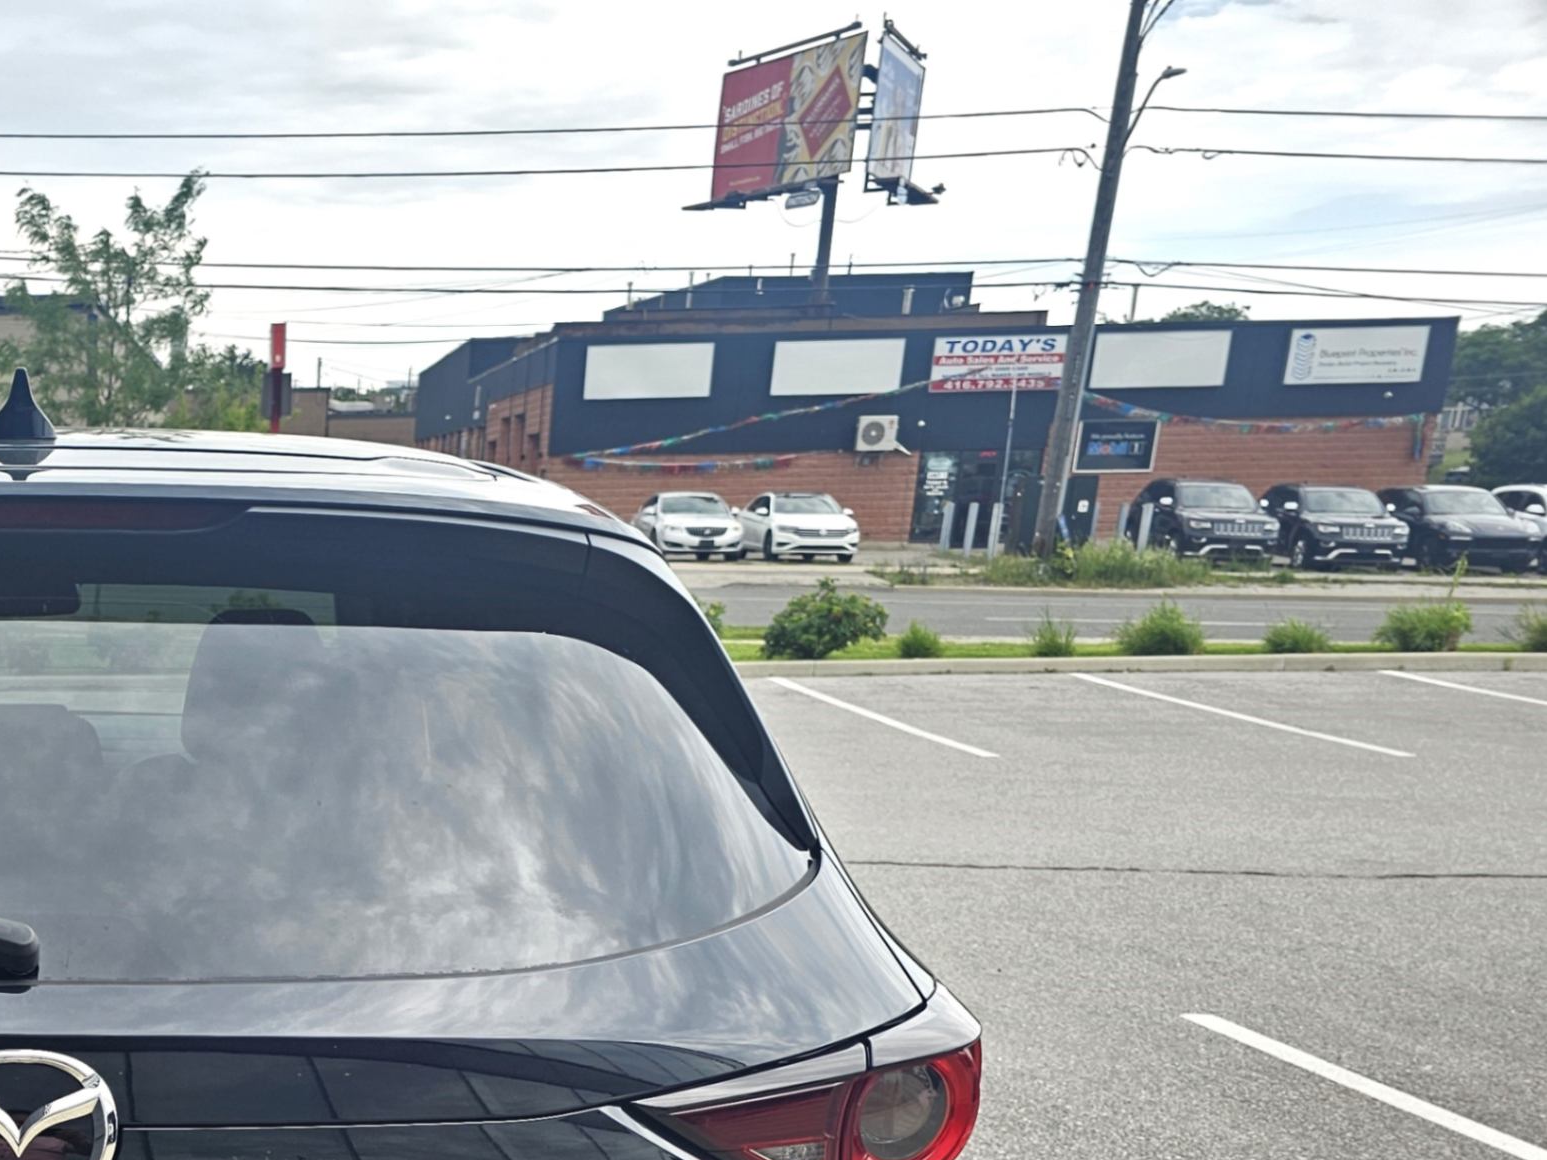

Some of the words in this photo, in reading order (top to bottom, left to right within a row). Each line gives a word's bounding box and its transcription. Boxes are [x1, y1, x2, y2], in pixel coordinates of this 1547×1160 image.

[946, 338, 1057, 354] TODAY'S
[938, 356, 964, 366] Auto
[966, 355, 995, 365] Sales
[1019, 354, 1061, 364] Service
[1086, 441, 1129, 456] Mobil
